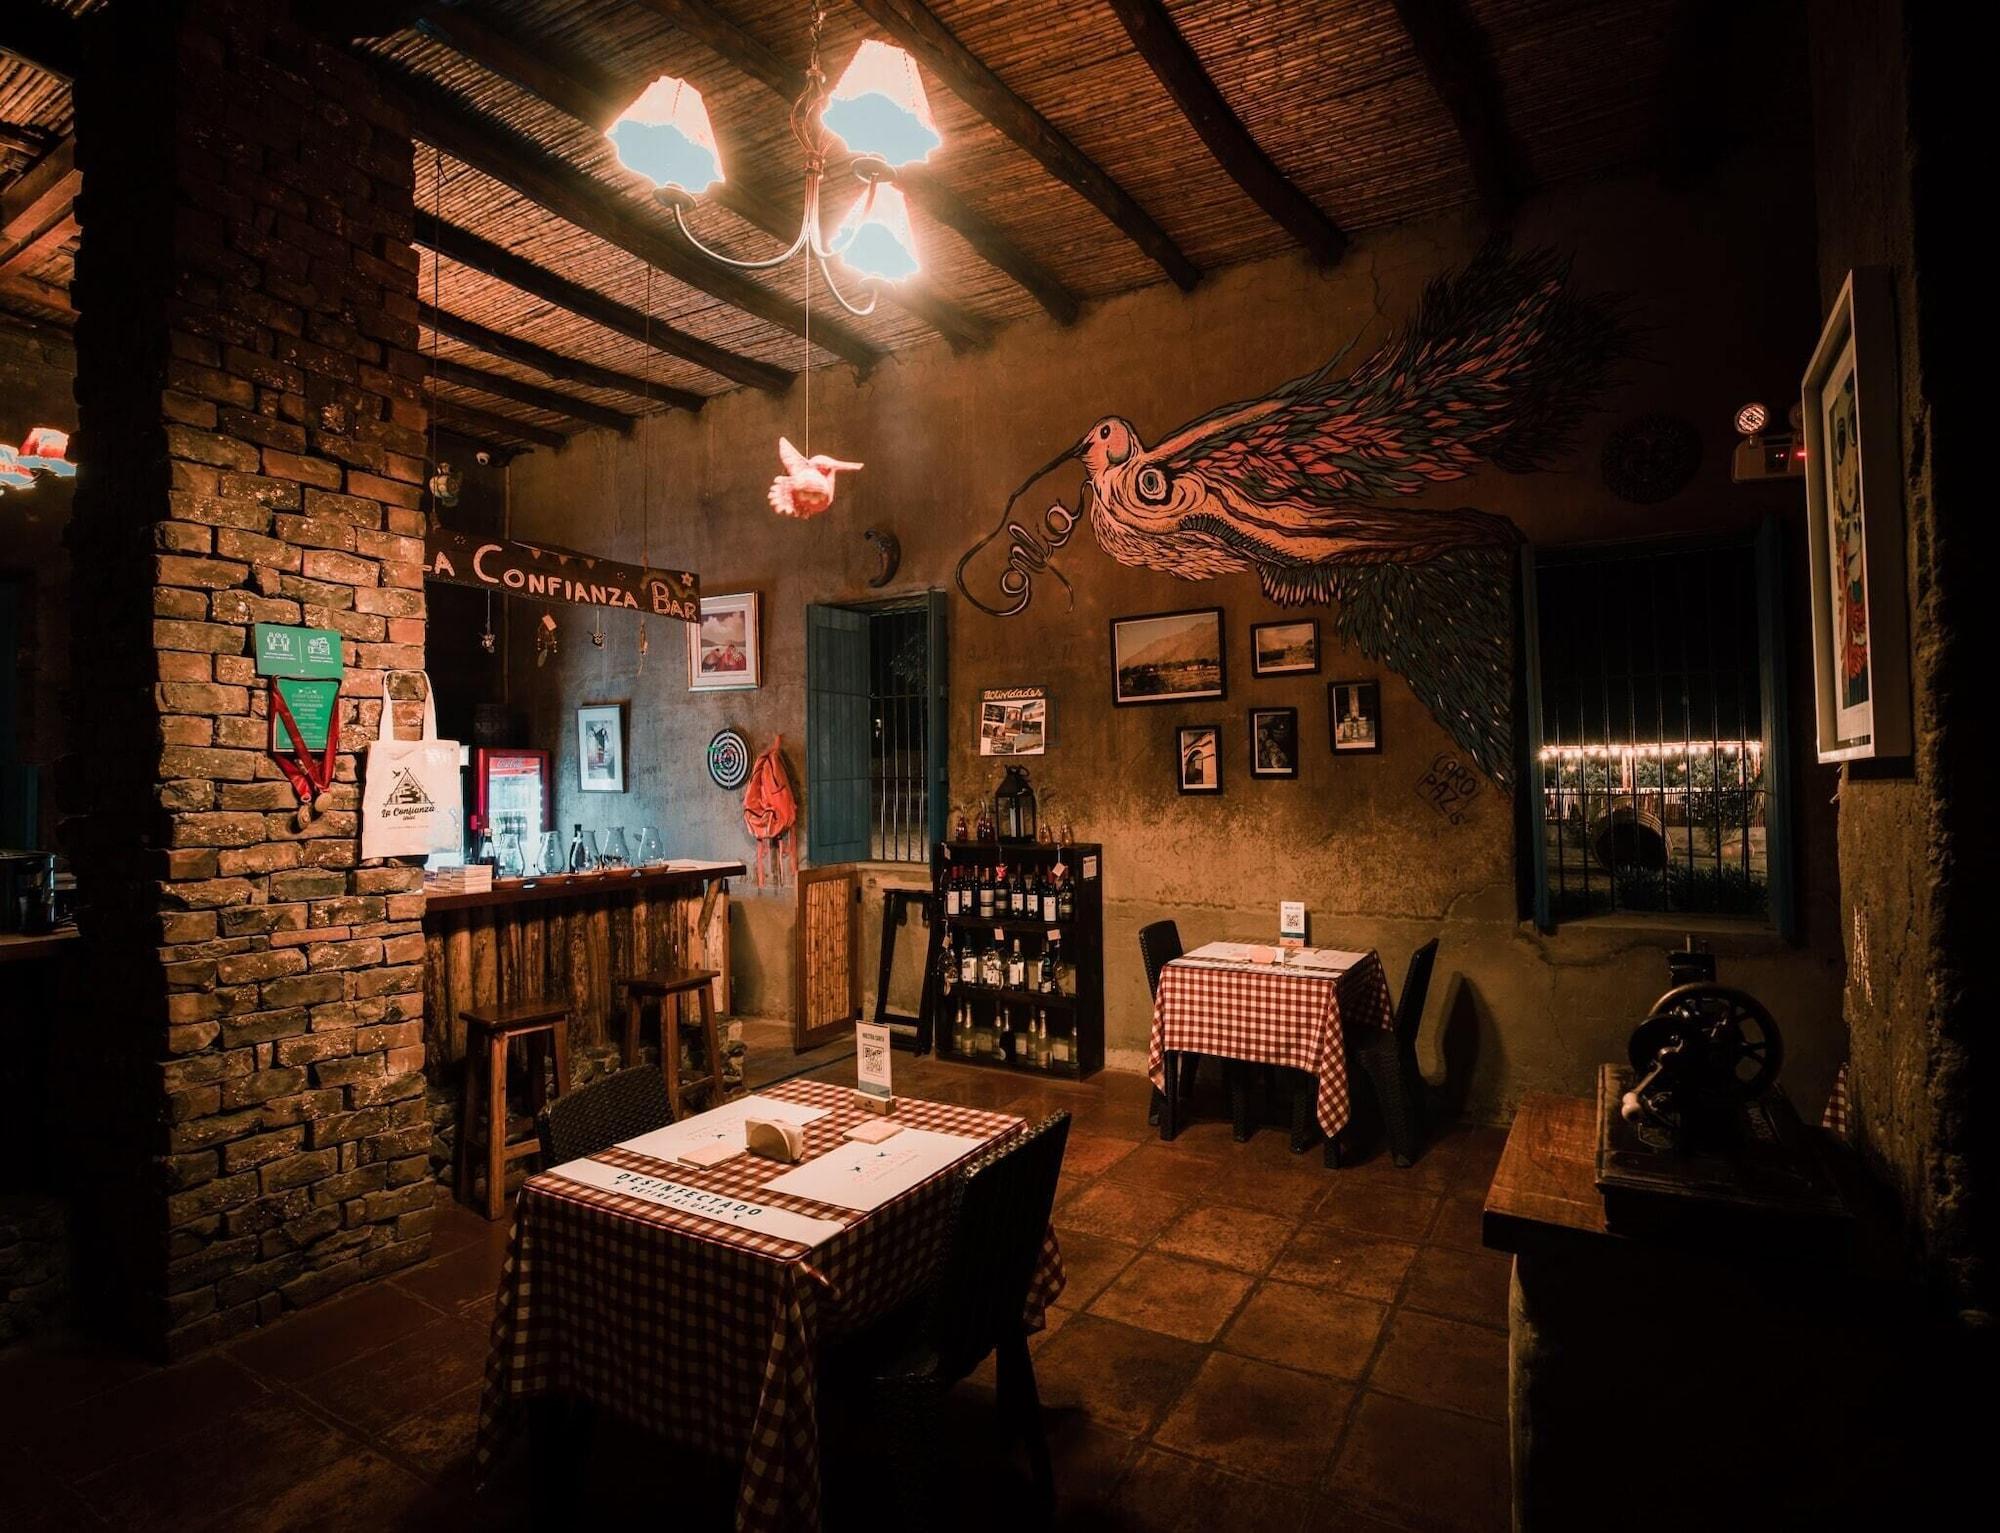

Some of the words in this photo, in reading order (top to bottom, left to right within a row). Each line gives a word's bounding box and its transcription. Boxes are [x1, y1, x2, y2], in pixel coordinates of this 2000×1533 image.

[472, 543, 639, 610] CONFIANZA
[651, 580, 698, 621] BAR
[393, 805, 435, 817] Confianza
[616, 1172, 763, 1216] DESINFECTADO
[687, 1200, 726, 1217] USAR
